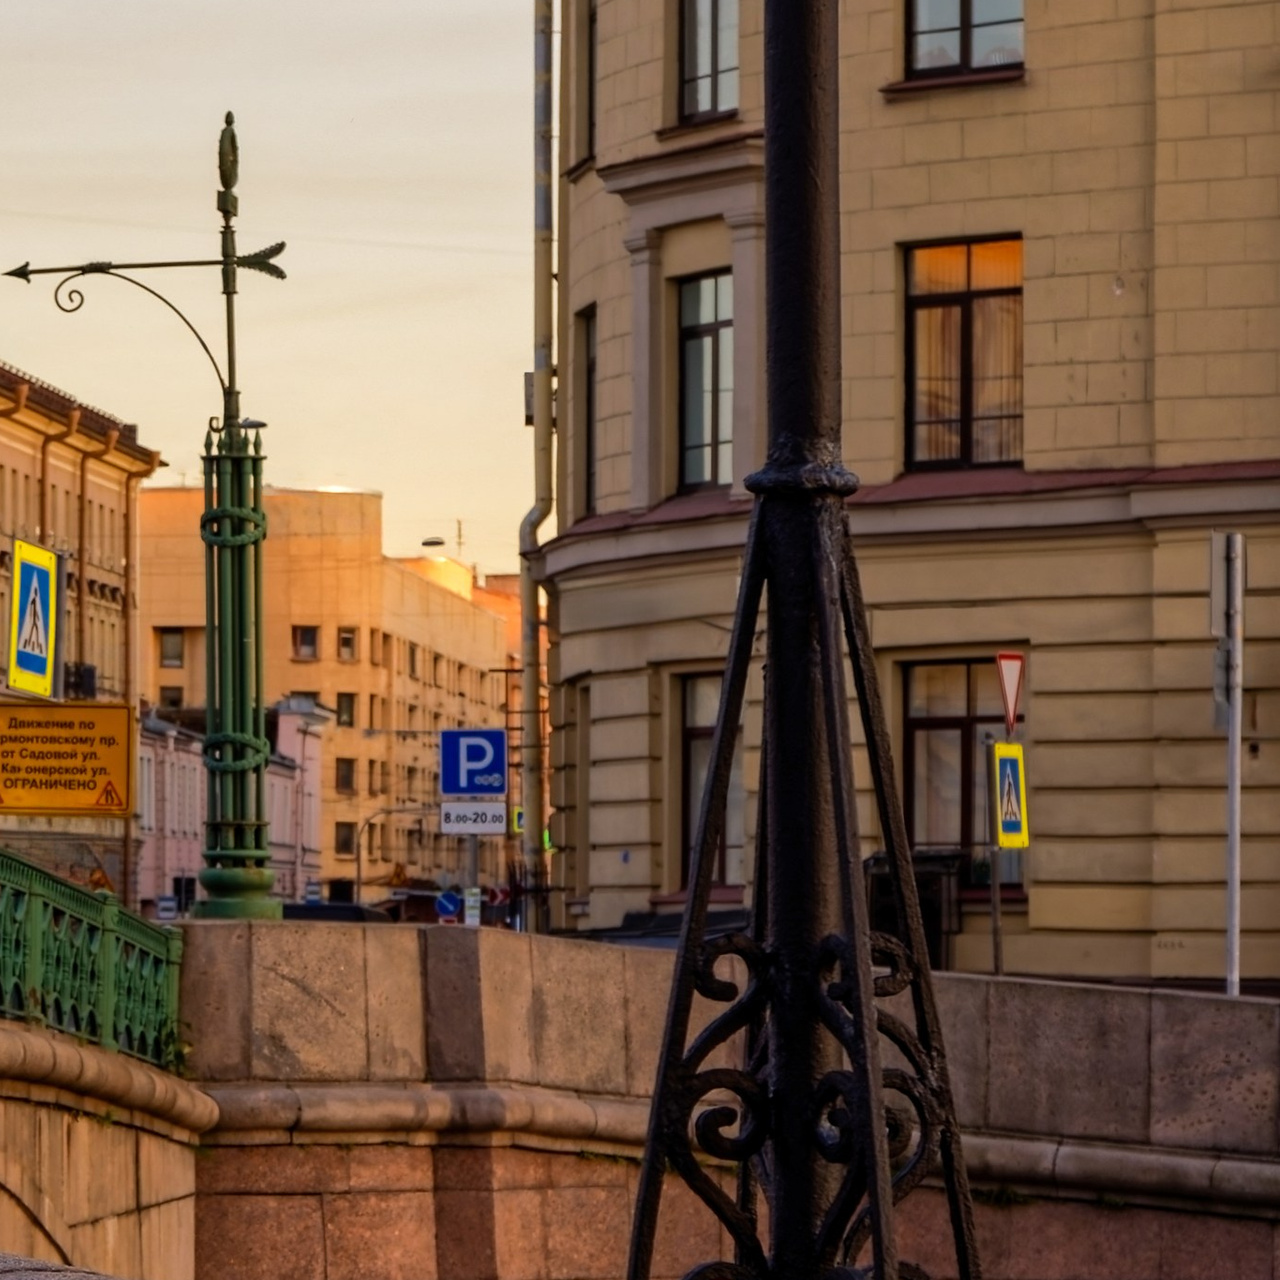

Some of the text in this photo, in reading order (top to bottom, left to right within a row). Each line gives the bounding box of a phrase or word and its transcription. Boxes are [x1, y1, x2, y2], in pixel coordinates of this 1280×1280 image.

[8, 718, 95, 730] Движение по
[100, 737, 119, 747] пр.
[1, 748, 100, 762] от Садовой ул.
[91, 767, 110, 778] ул.
[3, 778, 97, 791] ОГРАНИЧЕНО
